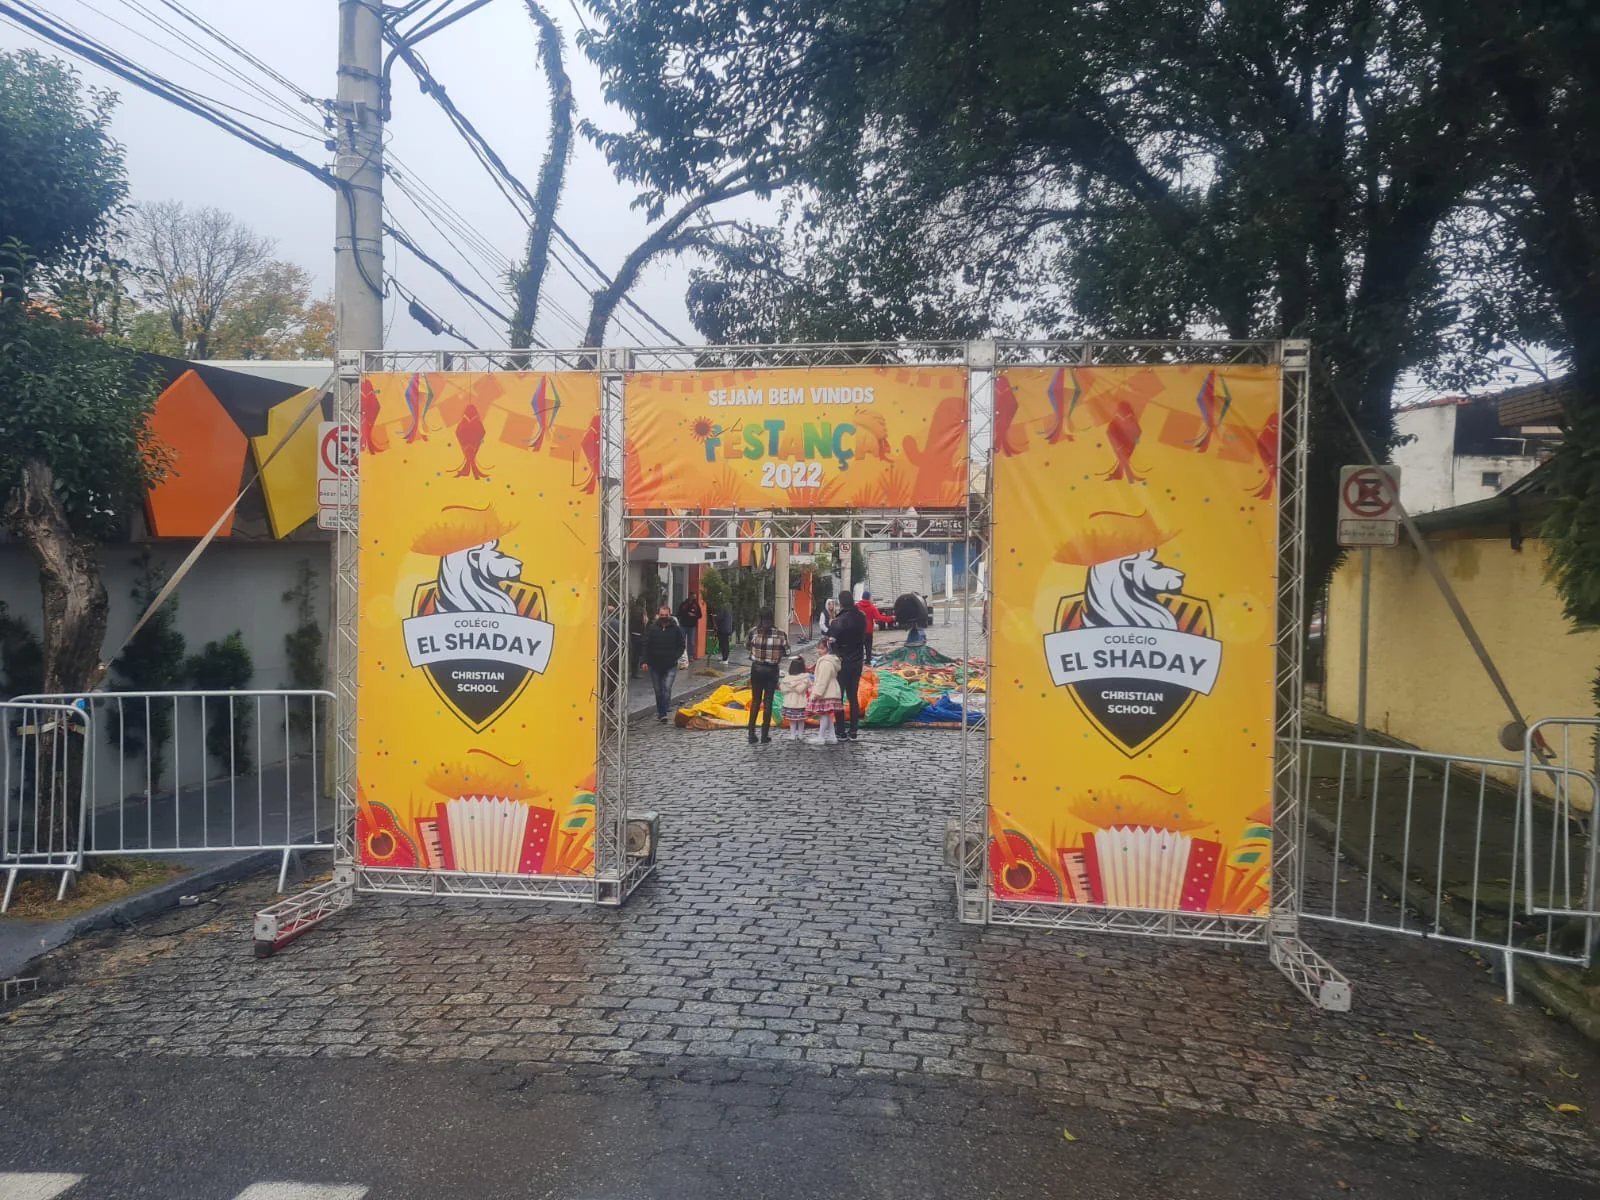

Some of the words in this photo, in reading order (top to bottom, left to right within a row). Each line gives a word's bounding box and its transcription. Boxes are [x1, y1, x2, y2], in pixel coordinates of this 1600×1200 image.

[708, 388, 763, 406] SEJAM
[768, 388, 804, 405] BEM
[810, 387, 874, 404] VINDOS
[760, 462, 823, 489] 2022
[454, 617, 500, 629] COLÉGIO
[416, 635, 441, 655] EL
[444, 632, 542, 656] SHADAY
[1104, 633, 1157, 646] COLÉGIO
[1060, 652, 1088, 673] EL
[1092, 648, 1208, 676] SHADAY
[451, 670, 505, 681] CHRISTIAN
[457, 683, 499, 693] SCHOOL
[1100, 690, 1164, 702] CHRISTIAN
[1107, 704, 1157, 715] SCHOOL
